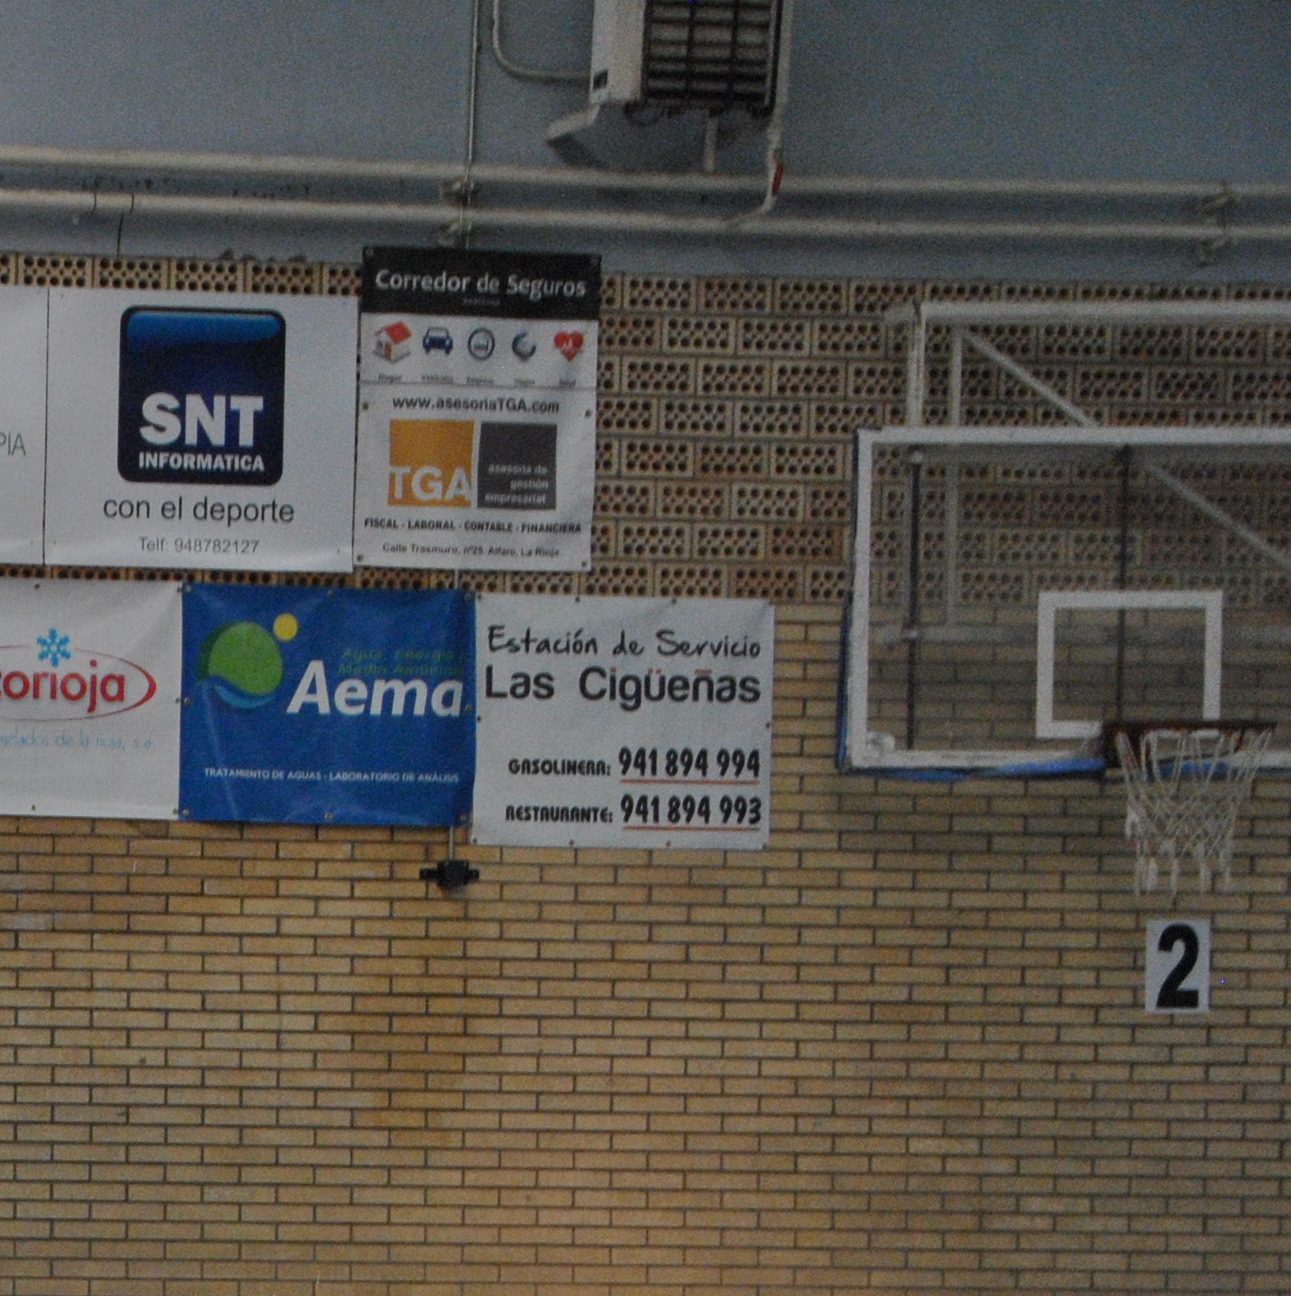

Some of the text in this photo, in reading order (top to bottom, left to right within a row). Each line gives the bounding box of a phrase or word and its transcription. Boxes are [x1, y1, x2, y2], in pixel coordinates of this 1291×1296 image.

[375, 270, 587, 300] Corredor de Seguros
[139, 391, 264, 448] SNT
[138, 451, 265, 473] INFORMATICA
[389, 465, 471, 503] TGA
[103, 496, 295, 528] con el deporte
[364, 518, 398, 530] FISCAL
[407, 519, 455, 531] LABORAL
[174, 537, 259, 554] 948782127
[488, 624, 761, 659] Estación de Servicio
[286, 659, 464, 717] Aema
[485, 665, 762, 711] Las Cigüeñas
[204, 767, 270, 780] TRATAMIENTO
[272, 769, 286, 780] DE
[287, 769, 321, 780] AGUAS
[329, 770, 400, 782] LABORATORIO
[402, 772, 415, 782] DE
[508, 747, 760, 778] GASOLINERA: 941 894 994
[505, 794, 762, 826] RESTAURANTE: 941 894 993
[1155, 923, 1202, 1010] 2
